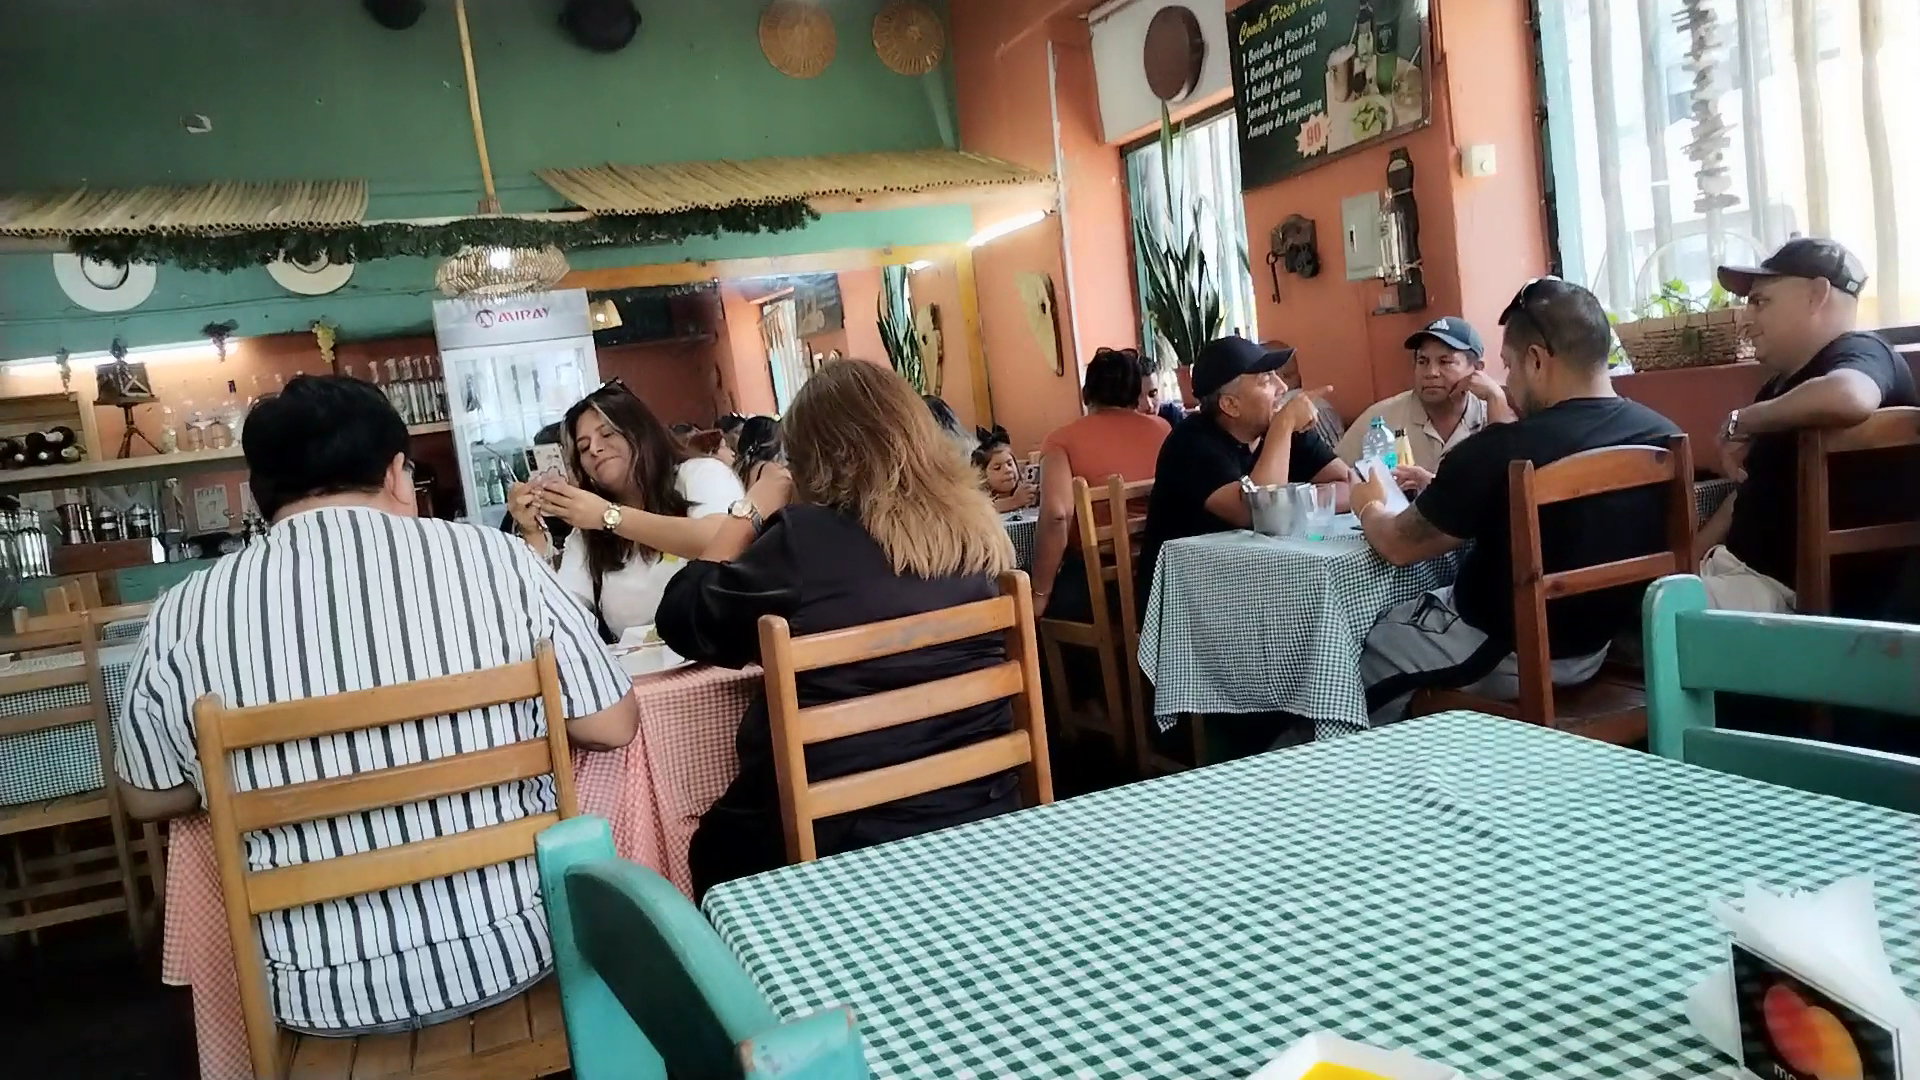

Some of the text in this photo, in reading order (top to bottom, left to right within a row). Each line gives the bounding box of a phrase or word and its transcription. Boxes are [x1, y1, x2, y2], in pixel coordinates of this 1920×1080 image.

[1239, 2, 1296, 45] Combo Pisco
[1242, 10, 1327, 68] 1 Botella de Pisco x 500
[1244, 71, 1248, 85] 1
[1249, 60, 1274, 83] Botella
[1275, 54, 1284, 70] de
[1246, 88, 1250, 103] 1
[1272, 75, 1281, 91] de
[1283, 65, 1302, 86] Hielo
[1270, 95, 1279, 111] de
[1247, 120, 1273, 139] Amargo
[1275, 113, 1284, 128] de
[498, 307, 551, 322] MIRAY
